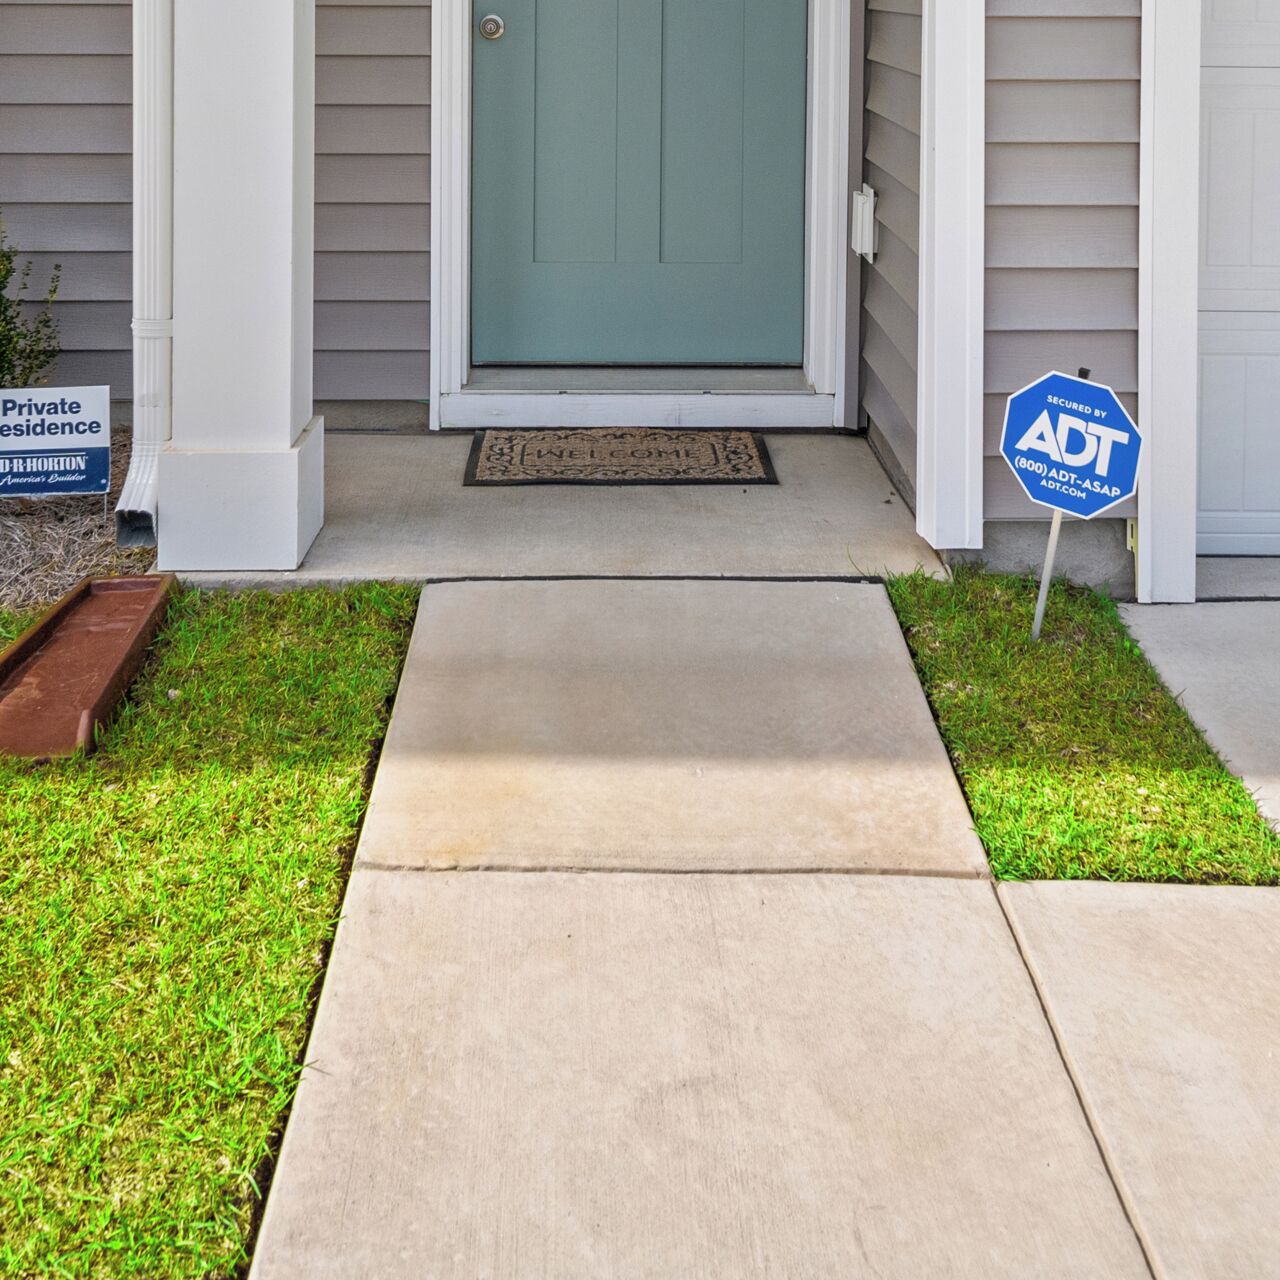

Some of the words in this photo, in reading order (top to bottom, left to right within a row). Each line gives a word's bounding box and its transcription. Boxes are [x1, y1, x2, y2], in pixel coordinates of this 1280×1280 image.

[2, 398, 82, 417] Private
[1047, 395, 1092, 414] SECURED
[1093, 406, 1108, 419] BY
[535, 448, 701, 459] WELCOME
[1014, 408, 1130, 477] ADT
[0, 474, 46, 486] America's
[47, 472, 86, 483] Builder
[1014, 455, 1048, 477] (800)
[1048, 468, 1121, 497] ADT-ASAP
[1040, 478, 1087, 500] ADT.COM
